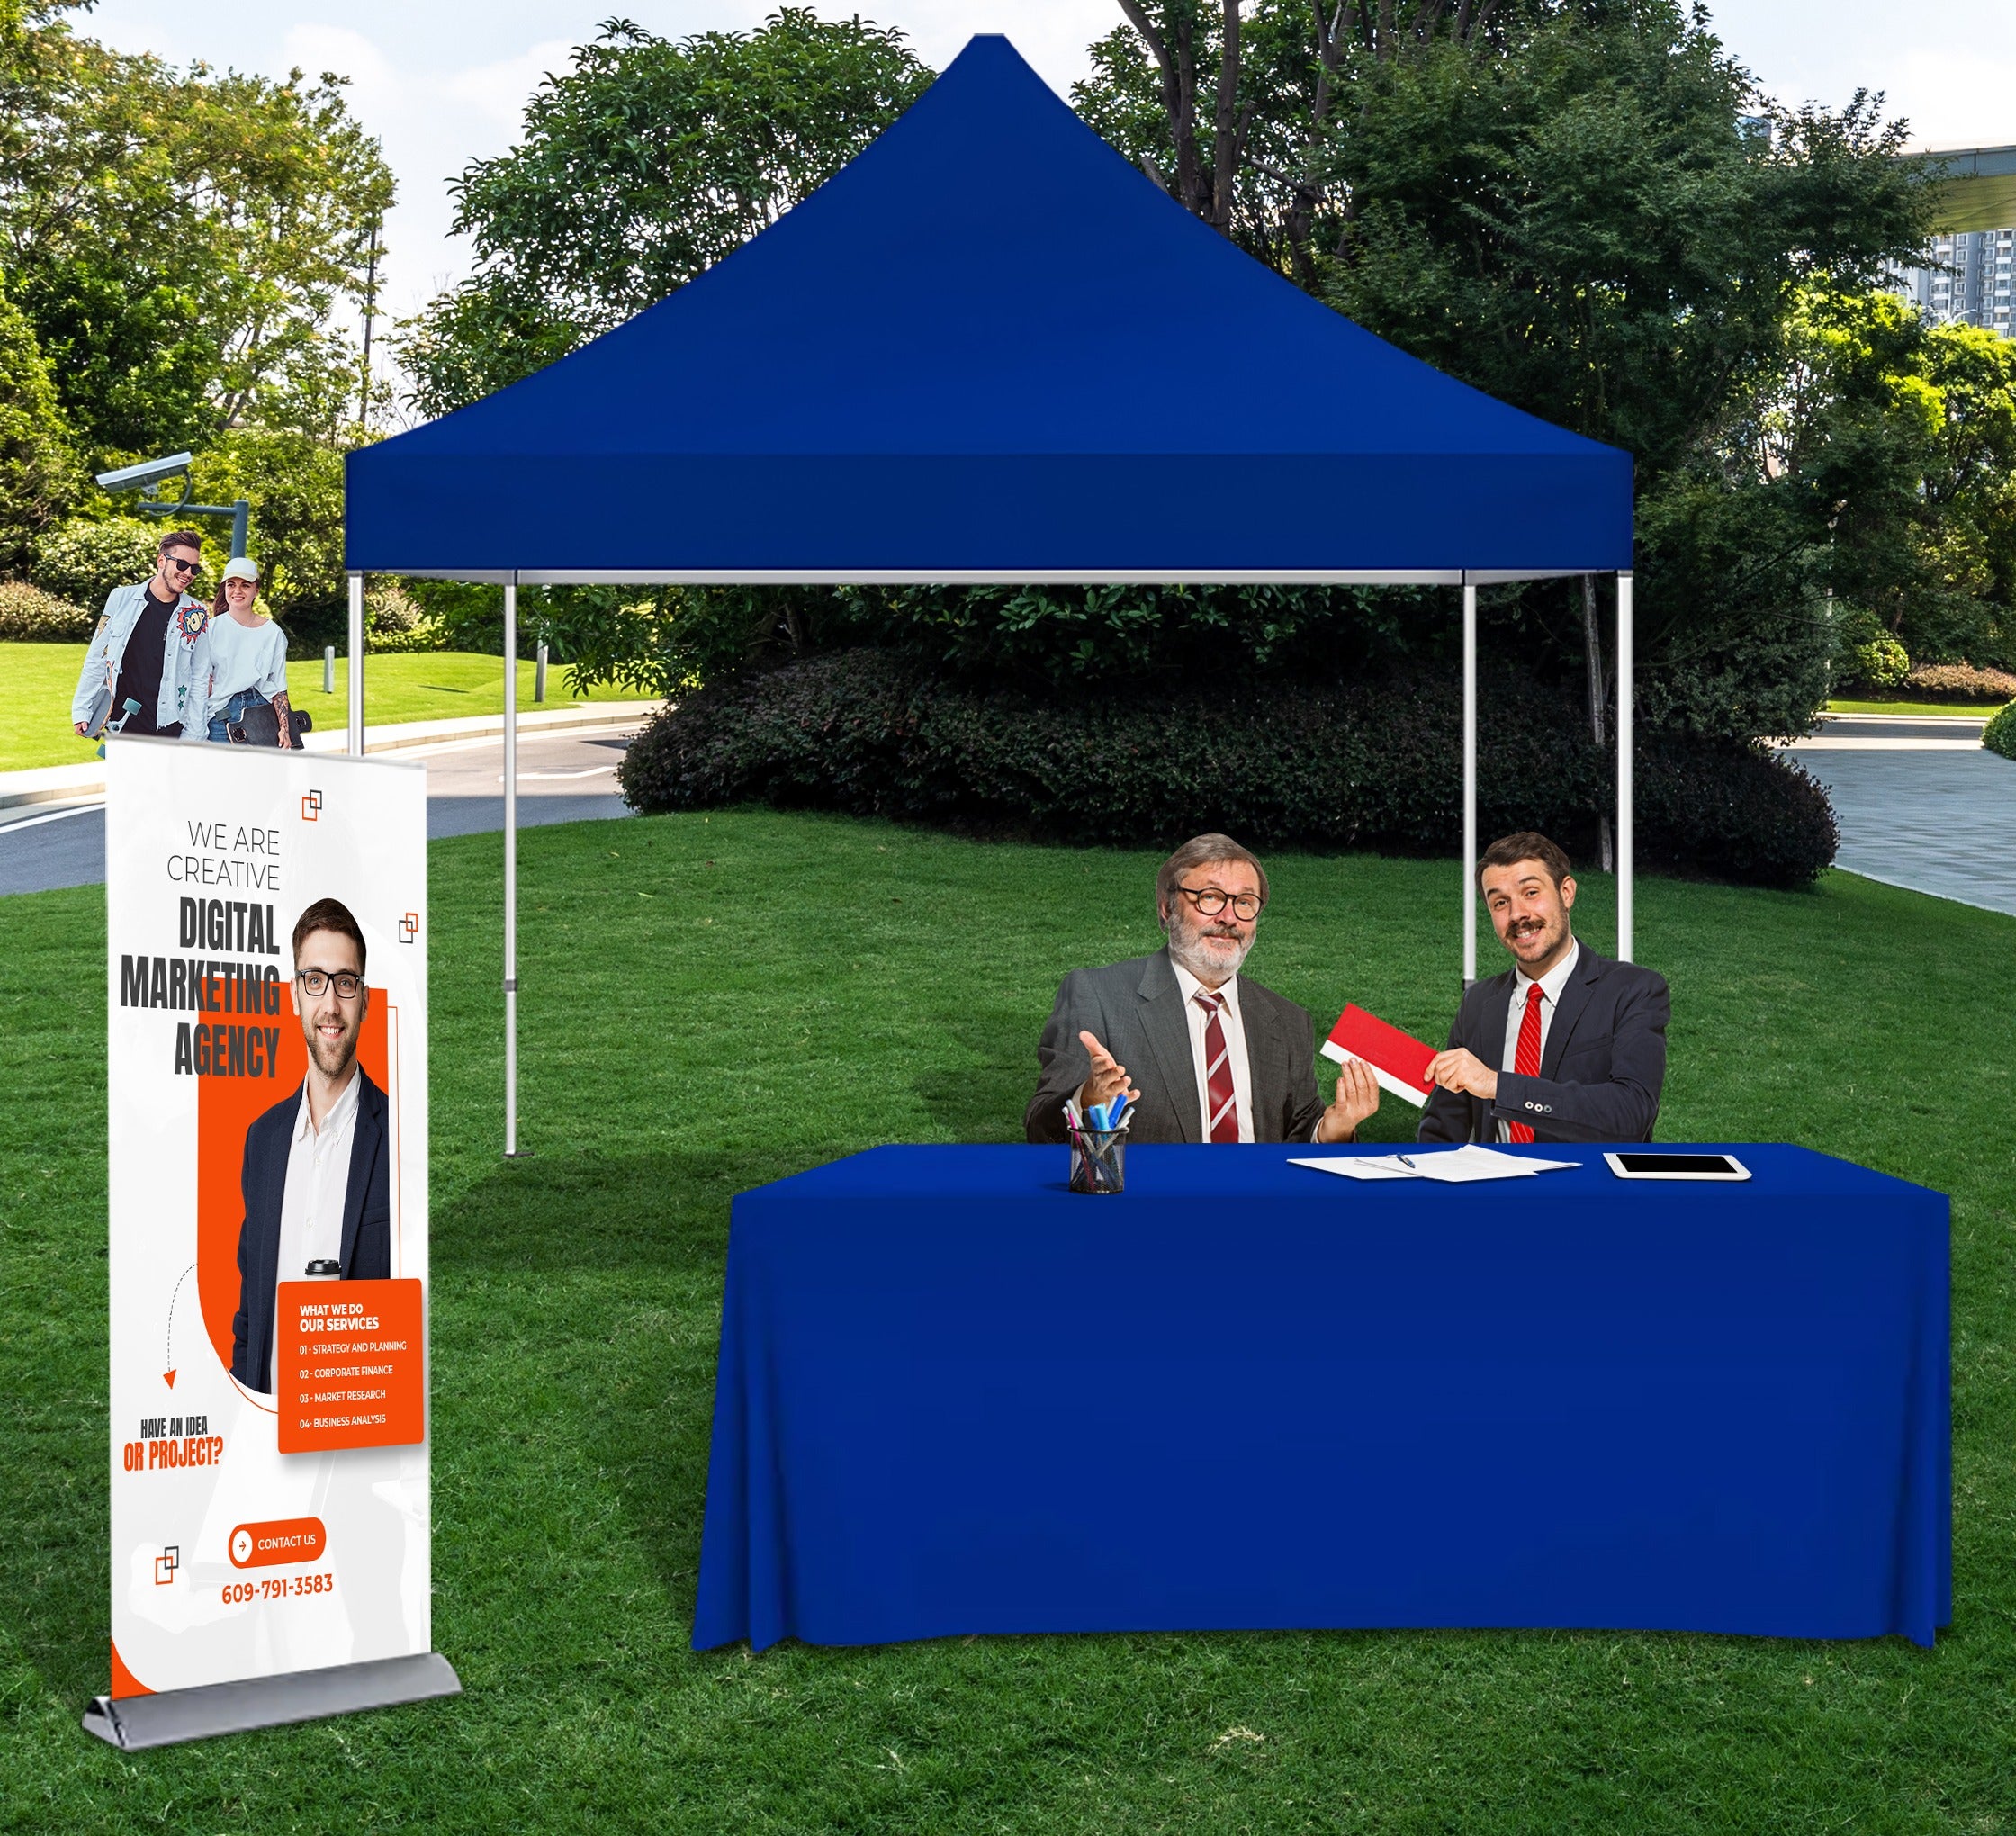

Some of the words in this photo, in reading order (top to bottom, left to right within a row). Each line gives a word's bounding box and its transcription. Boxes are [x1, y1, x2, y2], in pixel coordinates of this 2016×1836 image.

[184, 611, 206, 634] POP
[187, 820, 228, 850] WE
[233, 826, 280, 856] ARE
[167, 855, 280, 891] CREATIVE
[179, 896, 280, 955] DIGITAL
[121, 954, 281, 1016] MARKETING
[174, 1022, 280, 1078] AGENCY
[300, 1304, 329, 1317] WHAT
[331, 1304, 347, 1316] WE
[349, 1303, 364, 1315] DO
[300, 1318, 324, 1332] OUR
[327, 1317, 379, 1332] SERVICES
[299, 1345, 307, 1355] 01
[312, 1343, 351, 1354] STRATEGY
[351, 1342, 368, 1353] AND
[370, 1341, 407, 1352] PLANNING
[299, 1369, 309, 1379] 02
[314, 1366, 360, 1378] CORPORATE
[361, 1365, 393, 1376] FINANCE
[299, 1393, 309, 1404] 03
[314, 1391, 346, 1403] MARKET
[347, 1390, 386, 1400] RESEARCH
[140, 1418, 166, 1439] HAVE
[169, 1417, 183, 1436] AN
[185, 1415, 208, 1436] IDEA
[314, 1417, 350, 1428] BUSINESS
[351, 1414, 386, 1426] ANALYSIS
[123, 1441, 144, 1472] OR
[148, 1436, 224, 1470] PROJECT?
[257, 1534, 302, 1551] CONTACT
[303, 1534, 316, 1546] US
[221, 1573, 333, 1605] 609-791-3583
